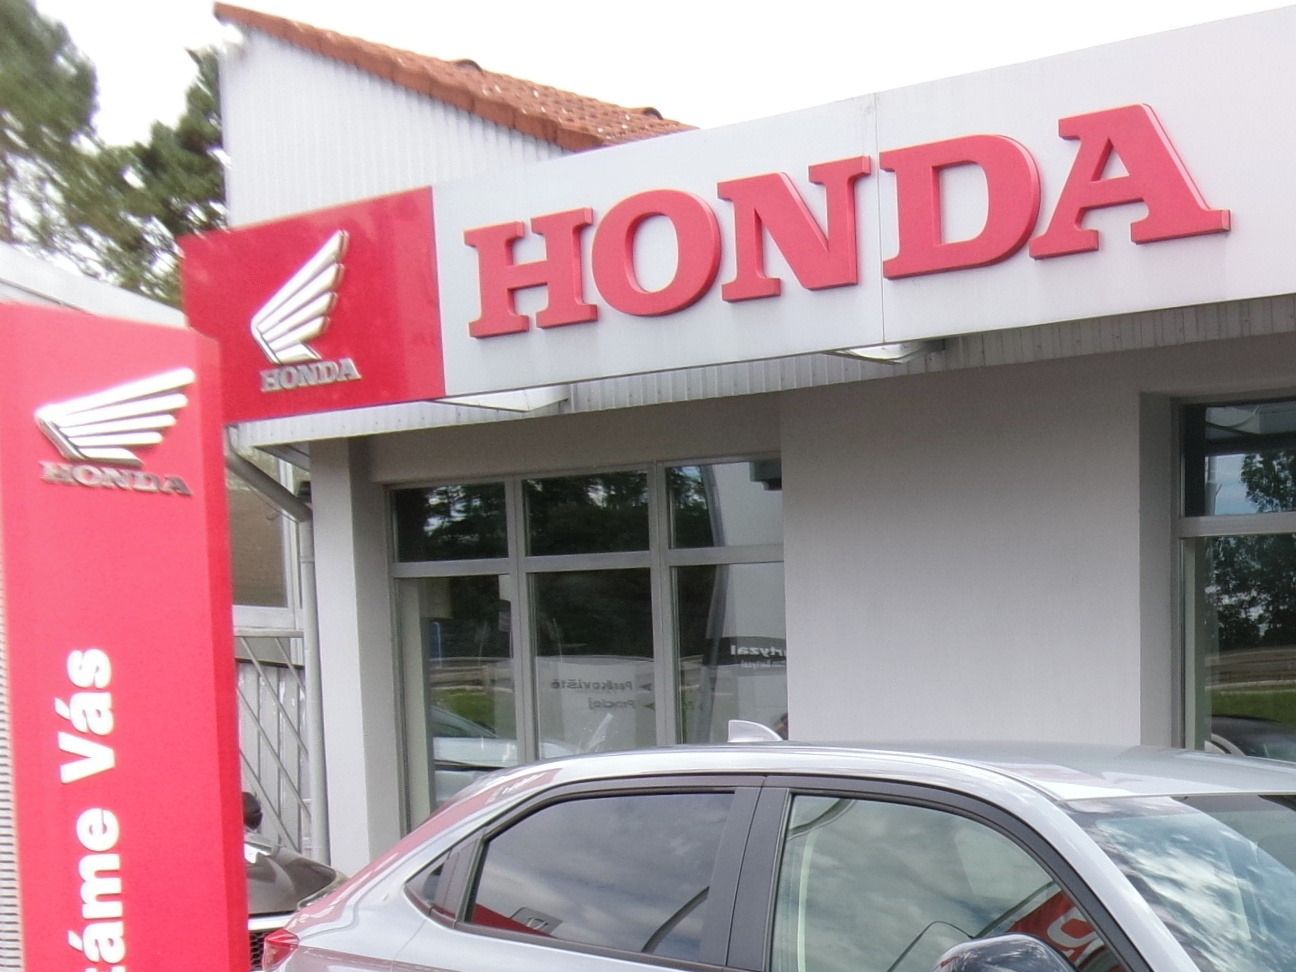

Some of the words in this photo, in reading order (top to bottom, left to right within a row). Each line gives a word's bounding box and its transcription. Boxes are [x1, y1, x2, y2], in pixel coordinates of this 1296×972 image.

[463, 103, 1232, 340] HONDA
[260, 358, 362, 393] HONDA
[38, 460, 193, 496] HONDA
[54, 648, 116, 785] Vás
